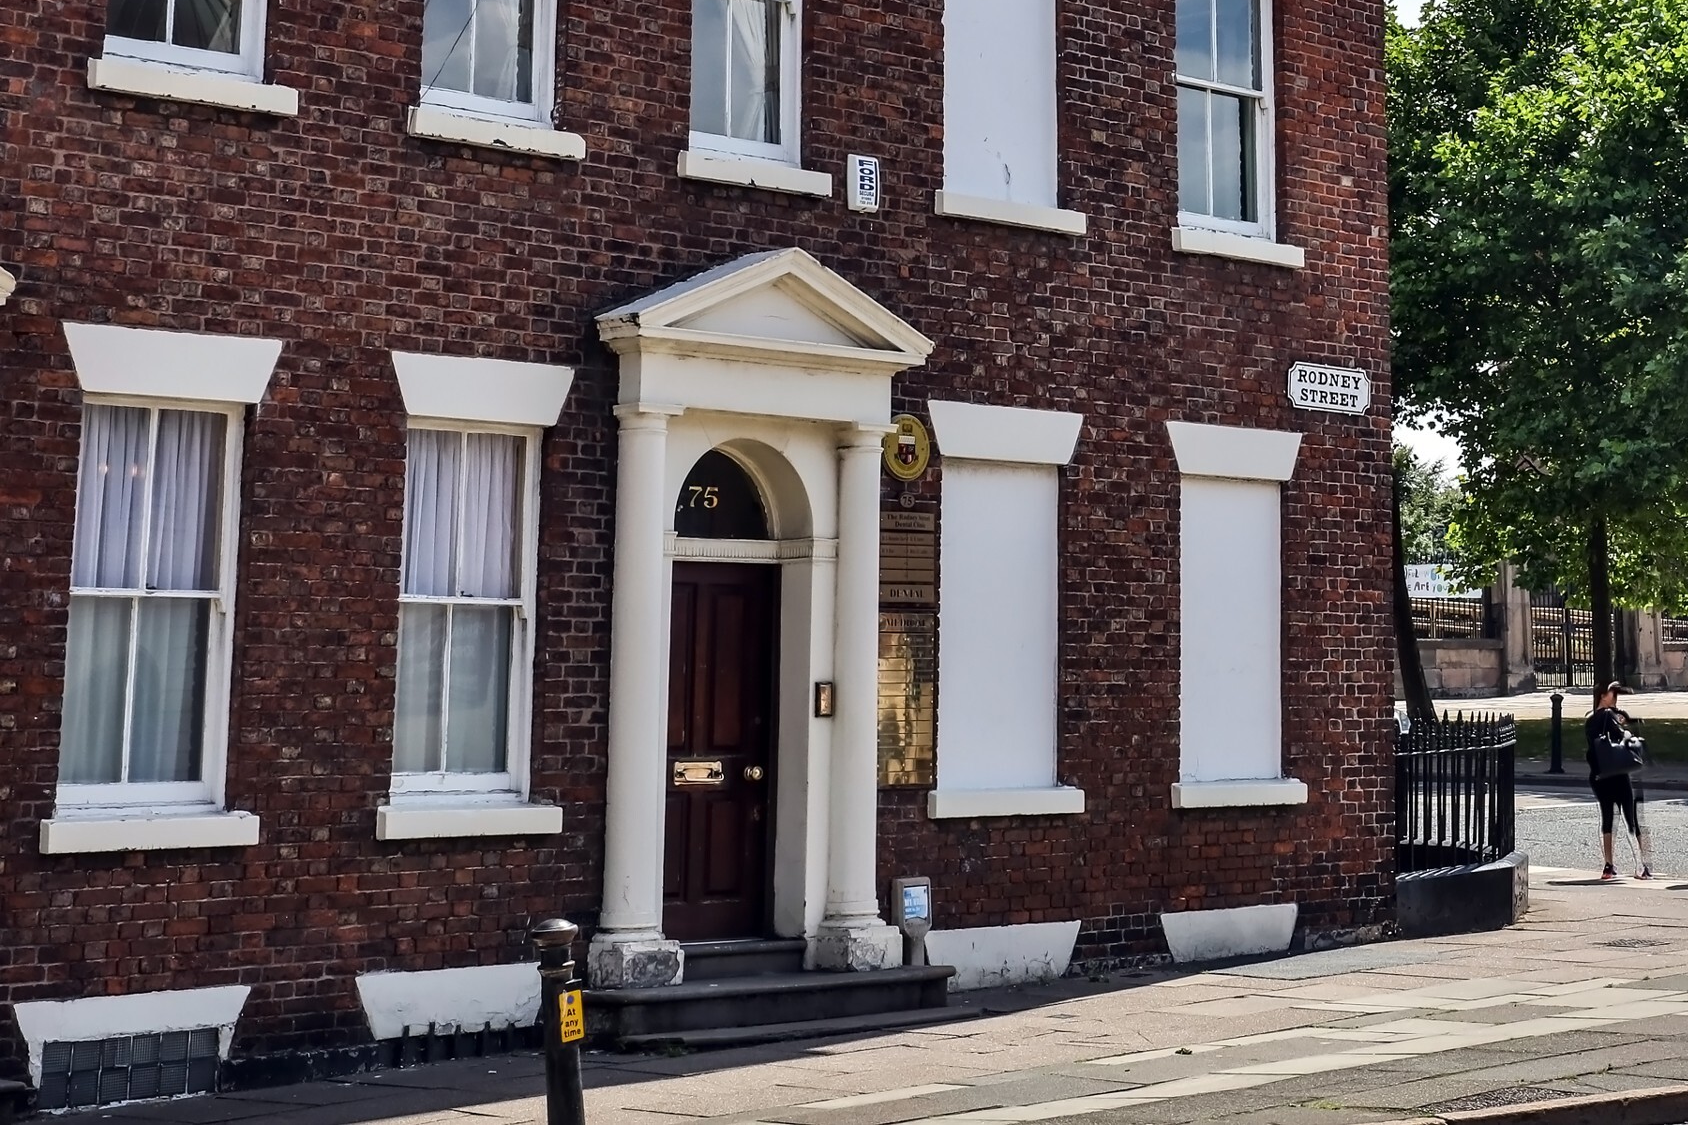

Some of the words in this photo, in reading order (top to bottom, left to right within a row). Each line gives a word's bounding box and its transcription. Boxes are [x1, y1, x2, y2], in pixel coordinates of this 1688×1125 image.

[859, 160, 874, 191] FORD
[1298, 369, 1362, 390] RODNEY
[1300, 388, 1358, 407] STREET
[688, 486, 719, 509] 75
[902, 496, 912, 506] 75
[890, 588, 923, 598] DENTAL
[886, 618, 926, 627] MEDICAL
[567, 1008, 576, 1017] At
[565, 1019, 578, 1028] any
[564, 1028, 581, 1038] time
